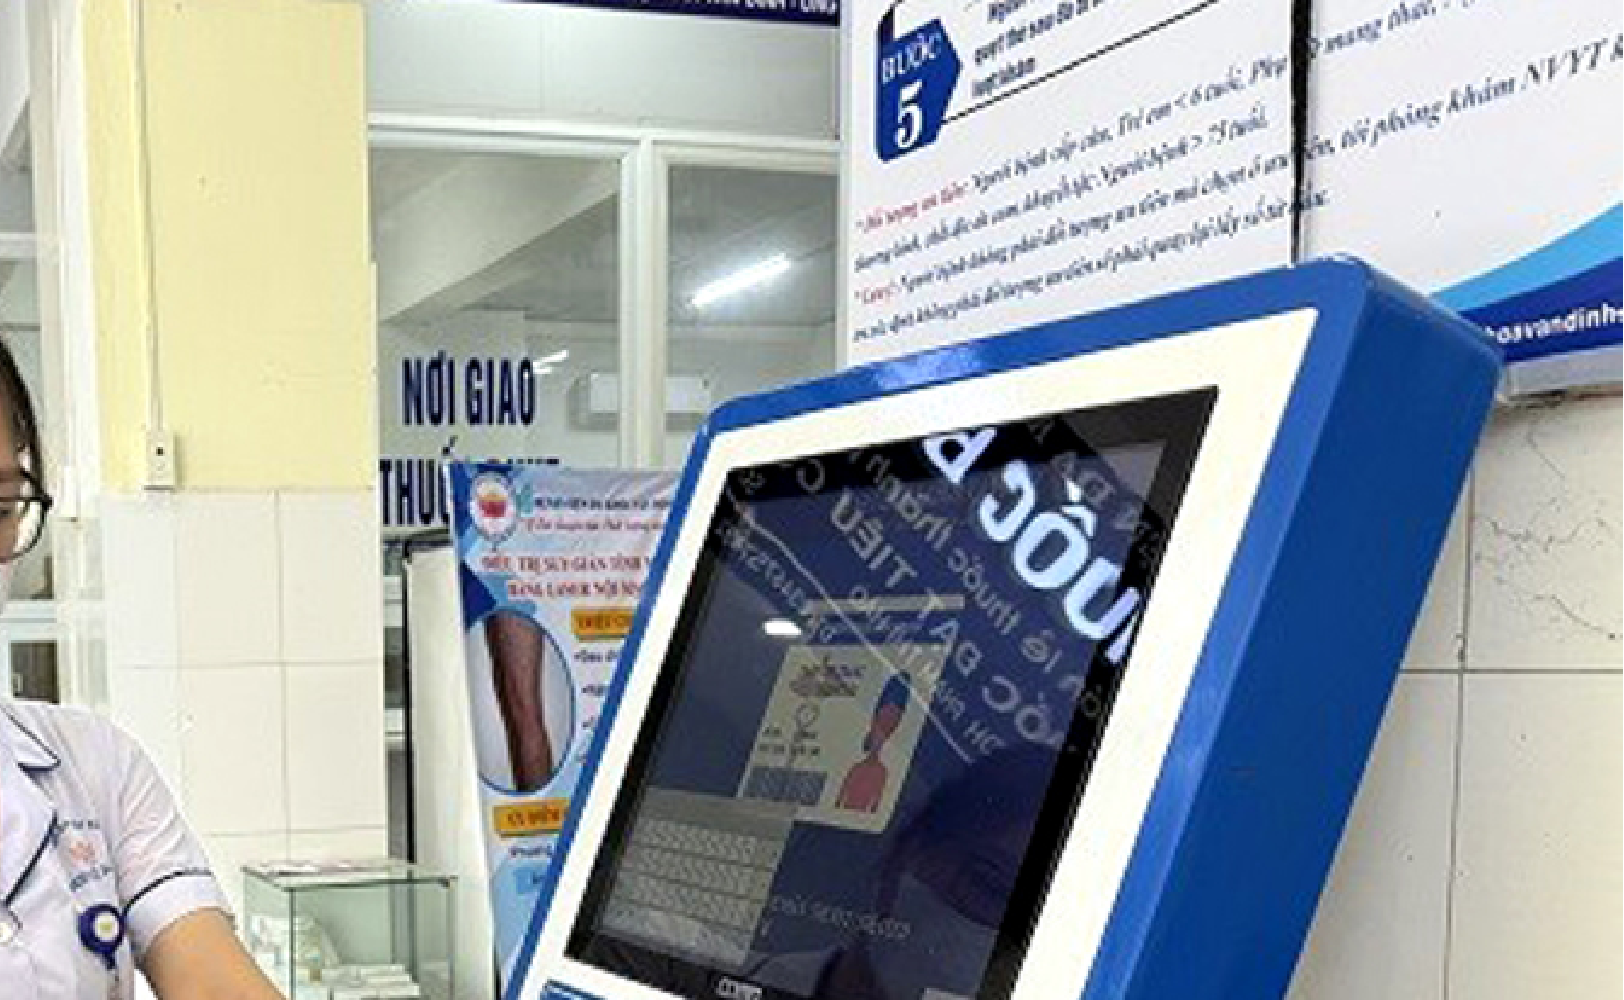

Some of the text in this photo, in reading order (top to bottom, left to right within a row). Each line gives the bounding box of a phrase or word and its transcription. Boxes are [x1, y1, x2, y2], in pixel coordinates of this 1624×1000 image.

[896, 79, 923, 149] 5
[401, 349, 536, 427] NƠI GIAO
